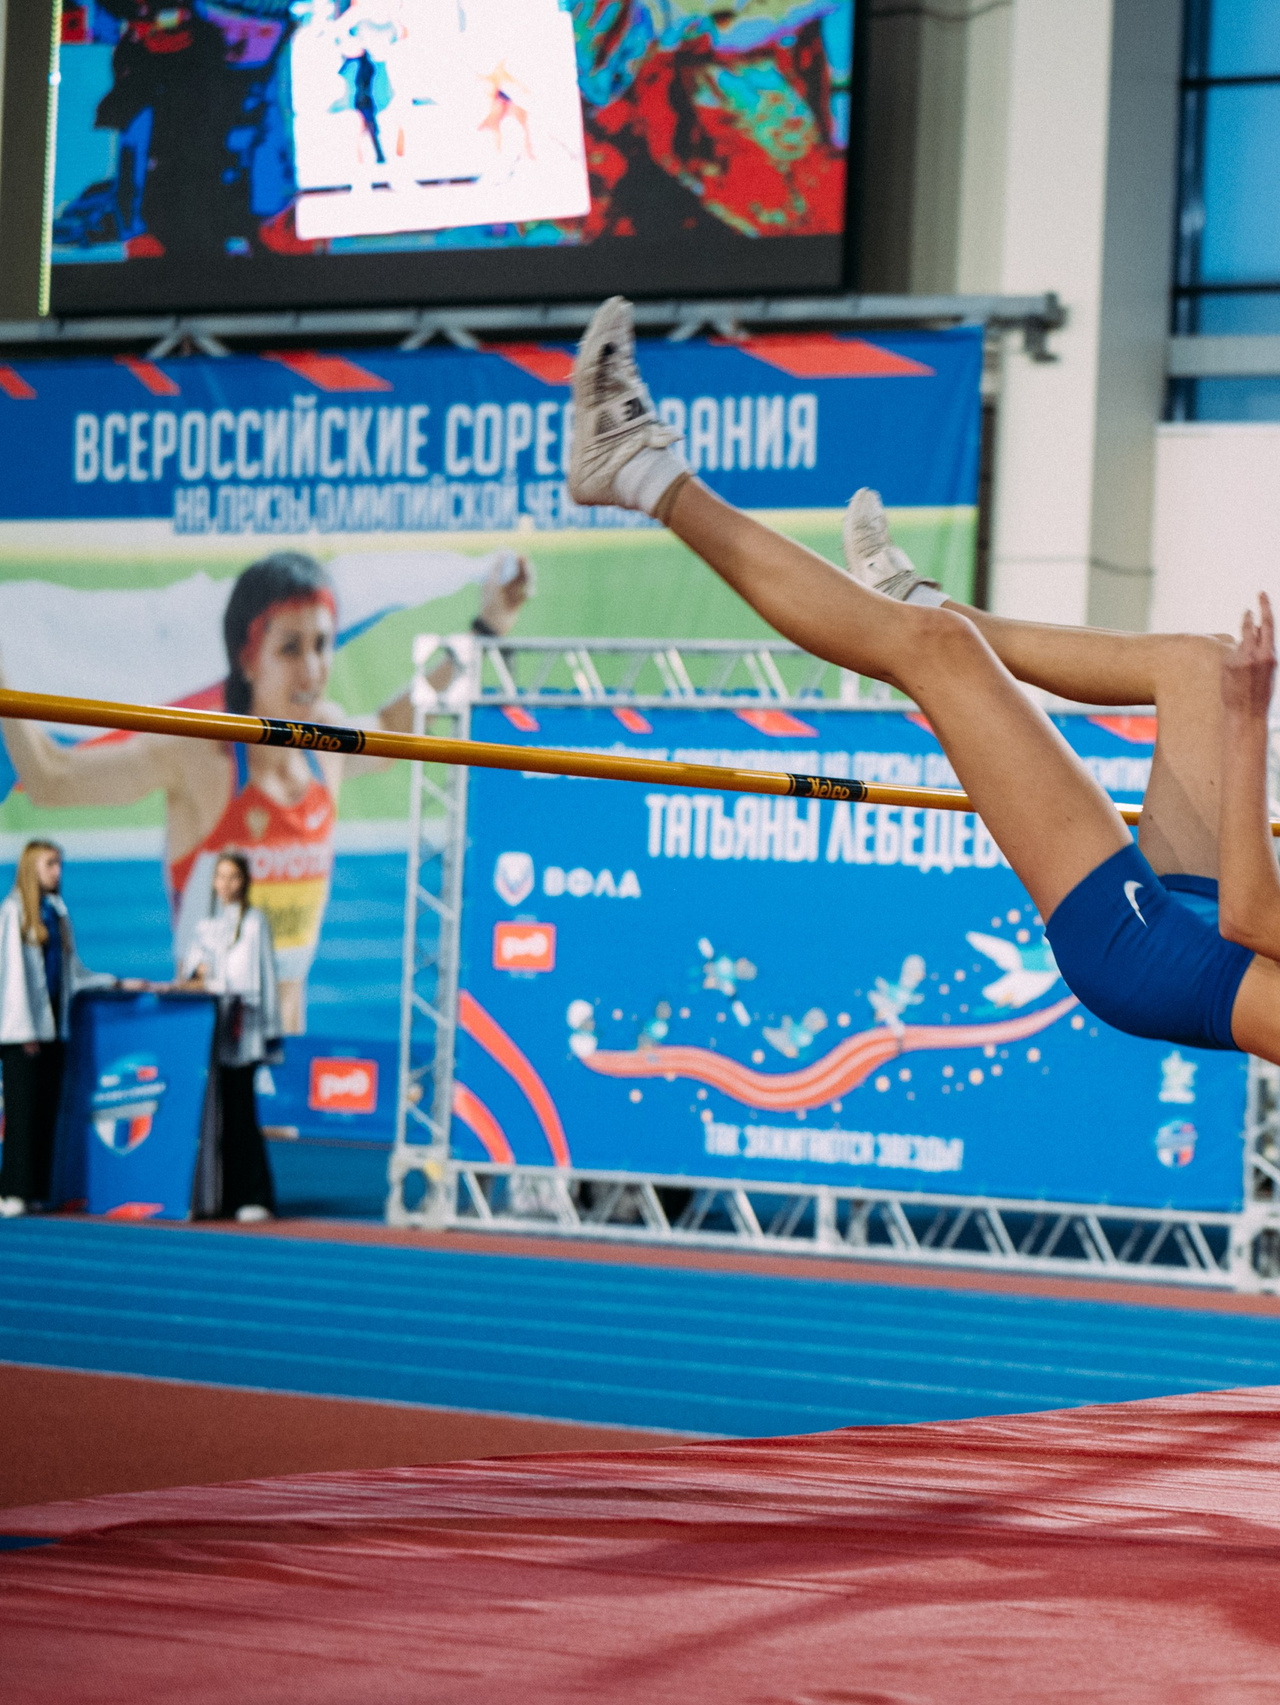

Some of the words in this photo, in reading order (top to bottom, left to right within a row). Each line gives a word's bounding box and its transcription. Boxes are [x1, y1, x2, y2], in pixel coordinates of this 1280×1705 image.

[74, 393, 430, 483] ВСЕРОССИЙСКИЕ
[285, 723, 341, 751] Nelco
[805, 777, 850, 799] Nelco
[645, 794, 820, 862] ТАТЬЯНЫ
